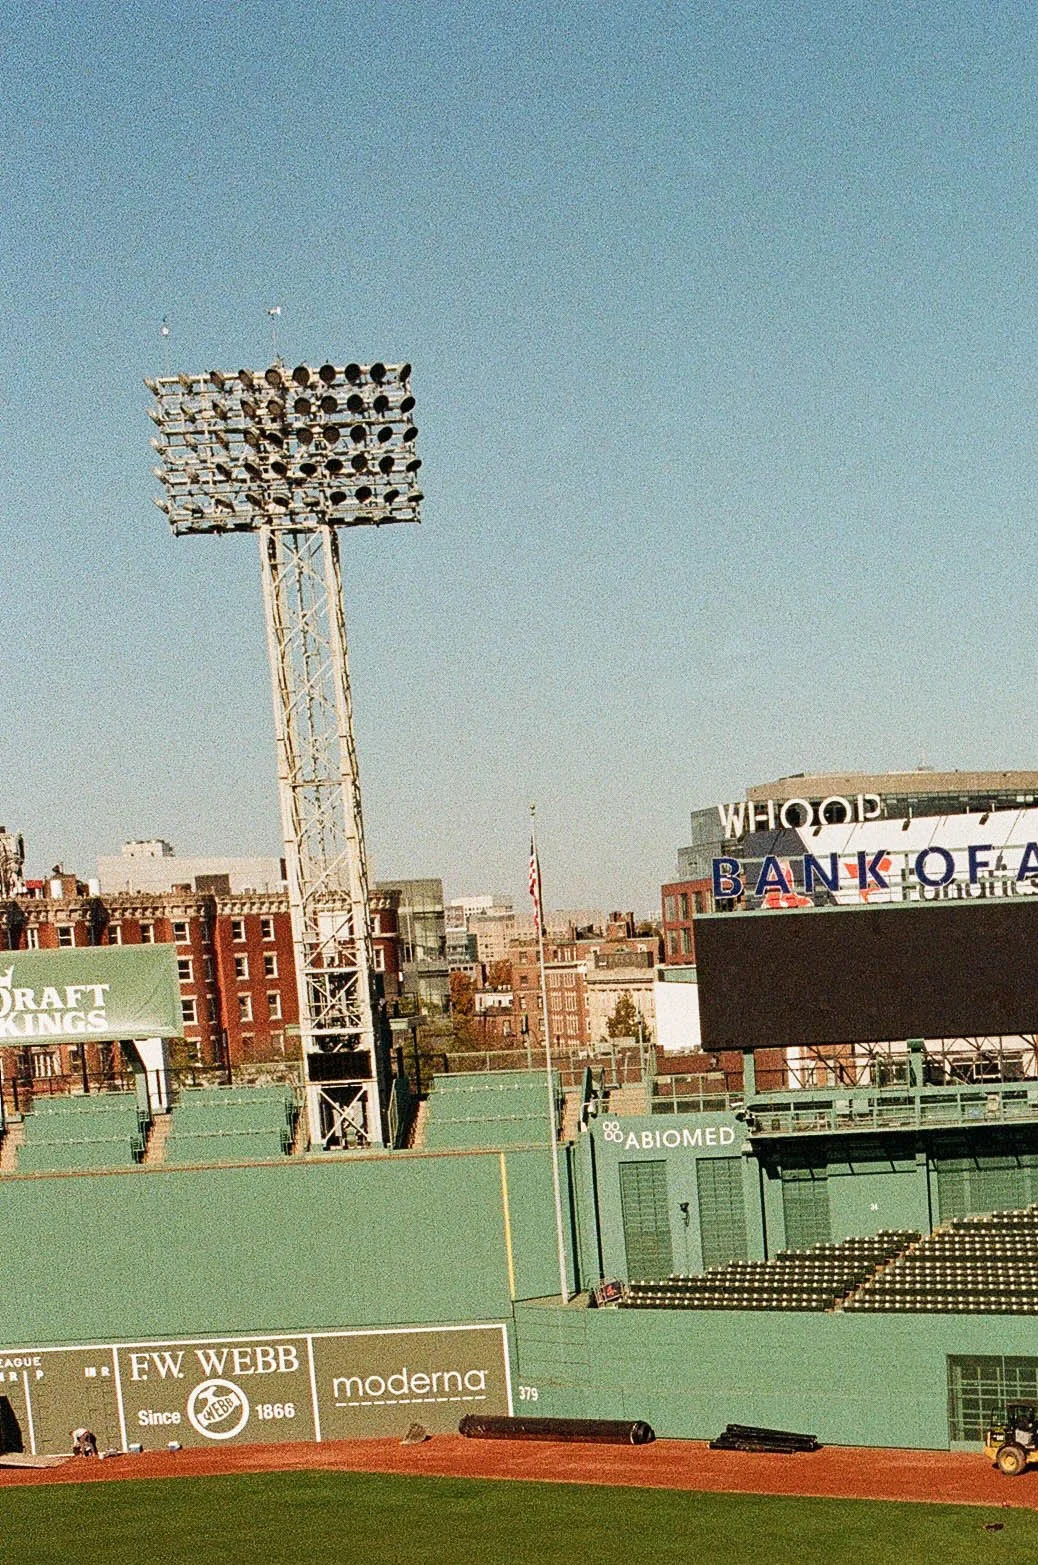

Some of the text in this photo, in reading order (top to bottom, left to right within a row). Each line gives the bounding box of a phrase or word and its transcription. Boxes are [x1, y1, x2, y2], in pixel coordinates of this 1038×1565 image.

[718, 794, 881, 839] WHOOP
[712, 849, 889, 899] BANK
[914, 844, 993, 888] OF
[624, 1126, 735, 1150] ABIOMED
[194, 1345, 300, 1377] WEBB
[333, 1367, 487, 1398] moderna
[519, 1386, 538, 1401] 379
[138, 1402, 295, 1426] Since 1866
[203, 1397, 234, 1421] WEBB
